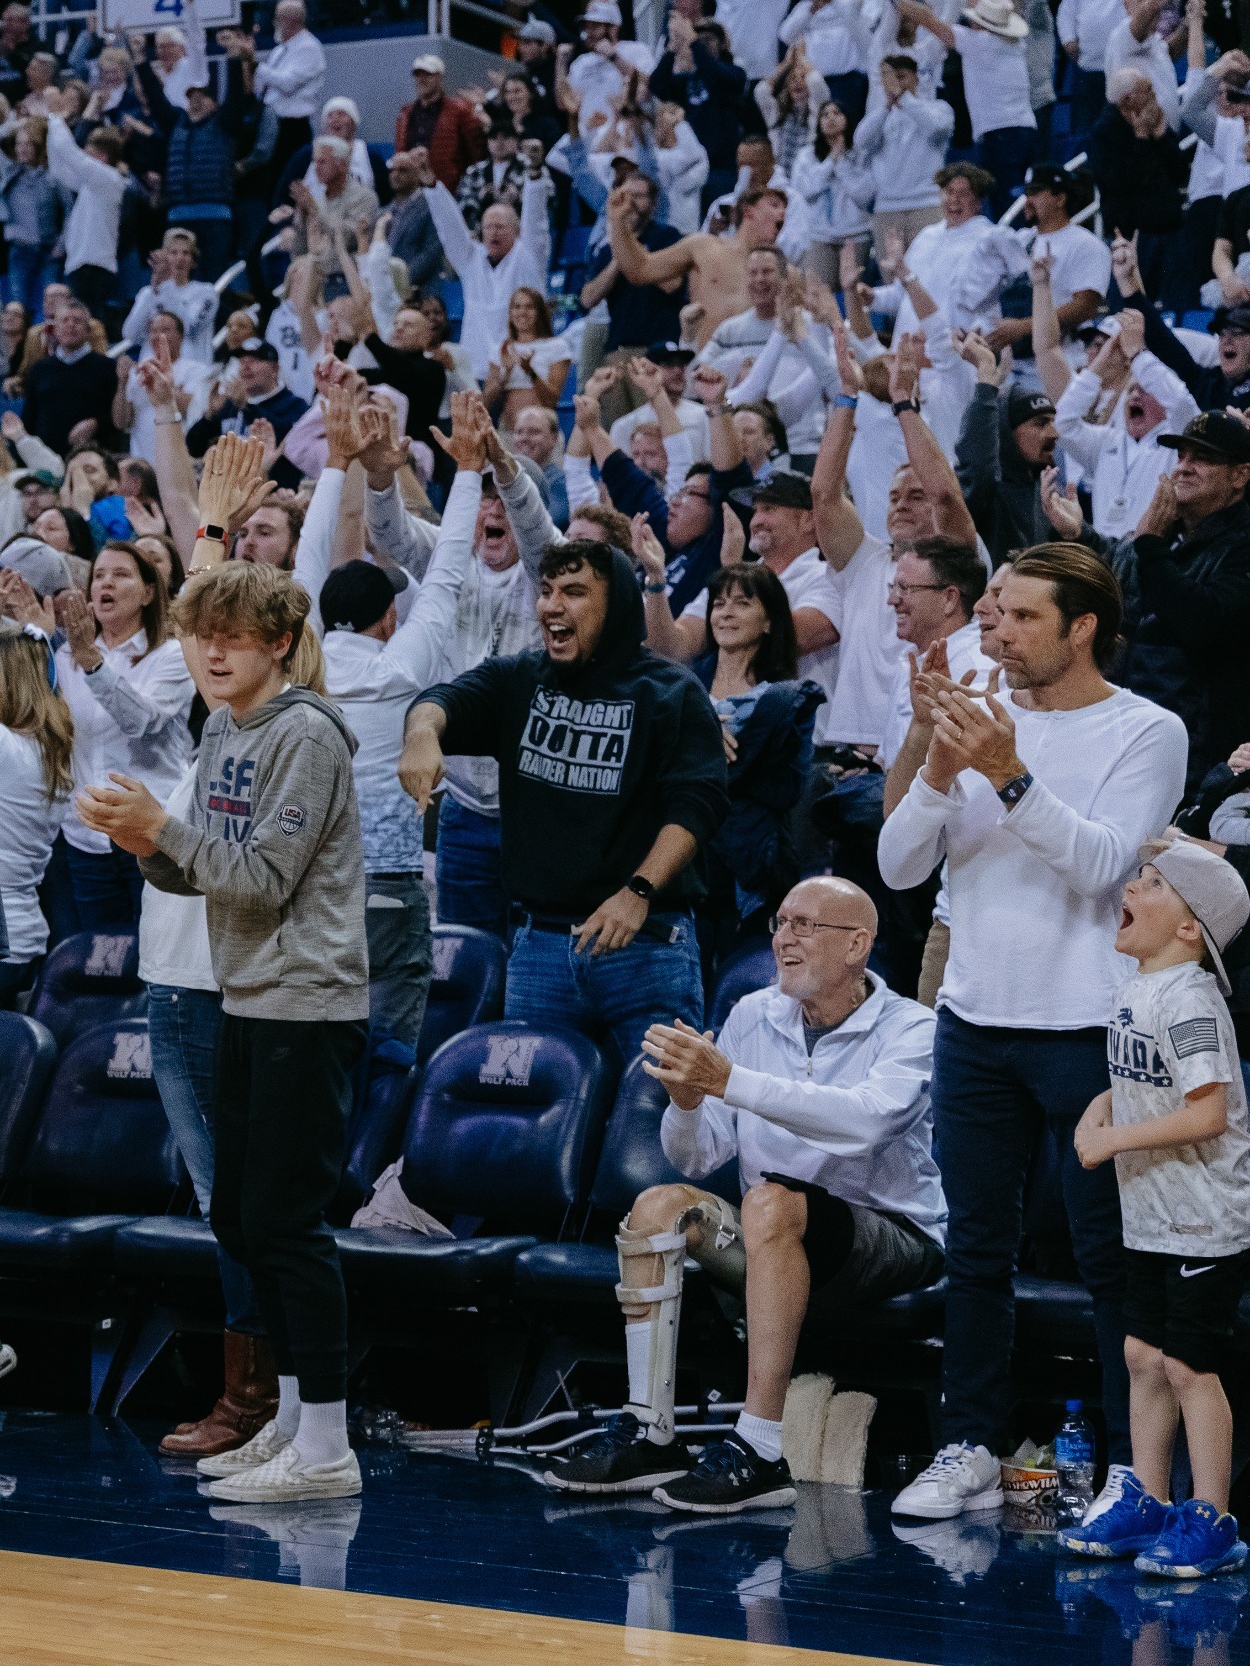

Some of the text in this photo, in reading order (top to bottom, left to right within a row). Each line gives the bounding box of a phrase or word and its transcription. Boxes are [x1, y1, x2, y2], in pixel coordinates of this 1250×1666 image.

[535, 690, 632, 729] SRAIGHT
[567, 764, 621, 791] NATION
[479, 1076, 529, 1087] WOLF PACK
